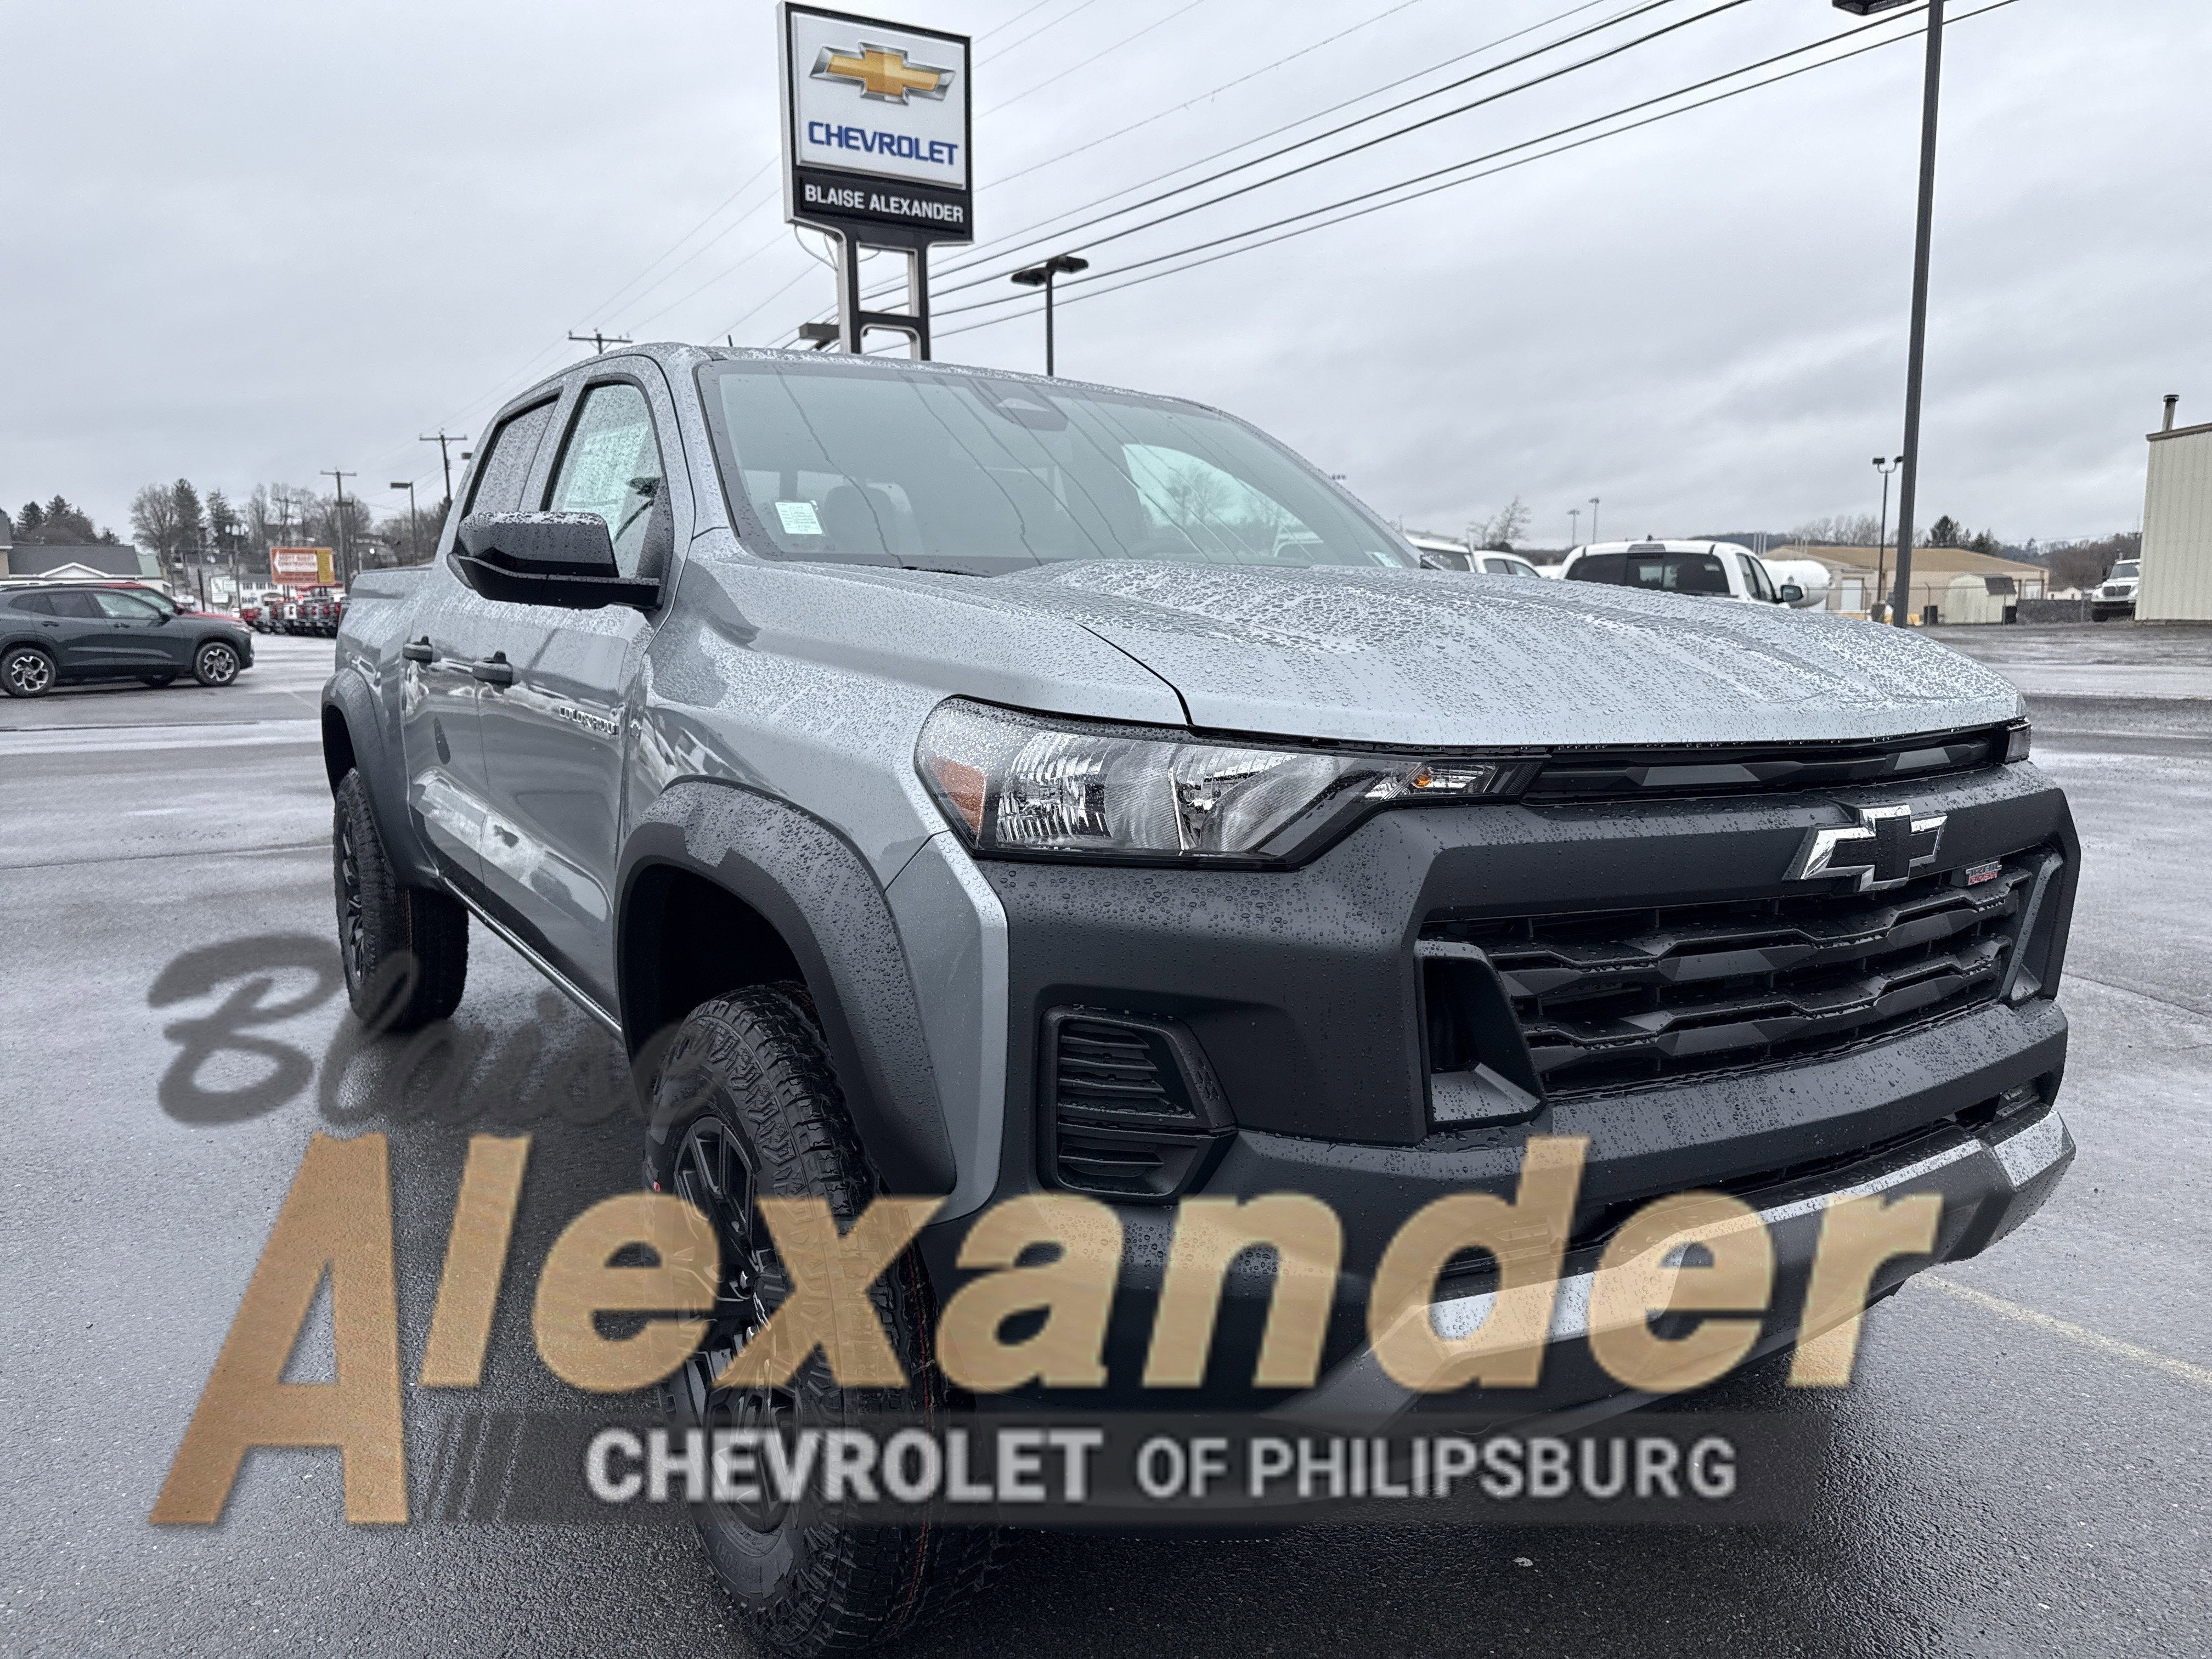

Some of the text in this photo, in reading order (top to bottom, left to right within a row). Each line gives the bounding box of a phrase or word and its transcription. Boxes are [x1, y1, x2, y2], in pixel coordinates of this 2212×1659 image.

[808, 121, 958, 166] CHEVROLET
[805, 184, 964, 223] BLAISE ALEXANDER
